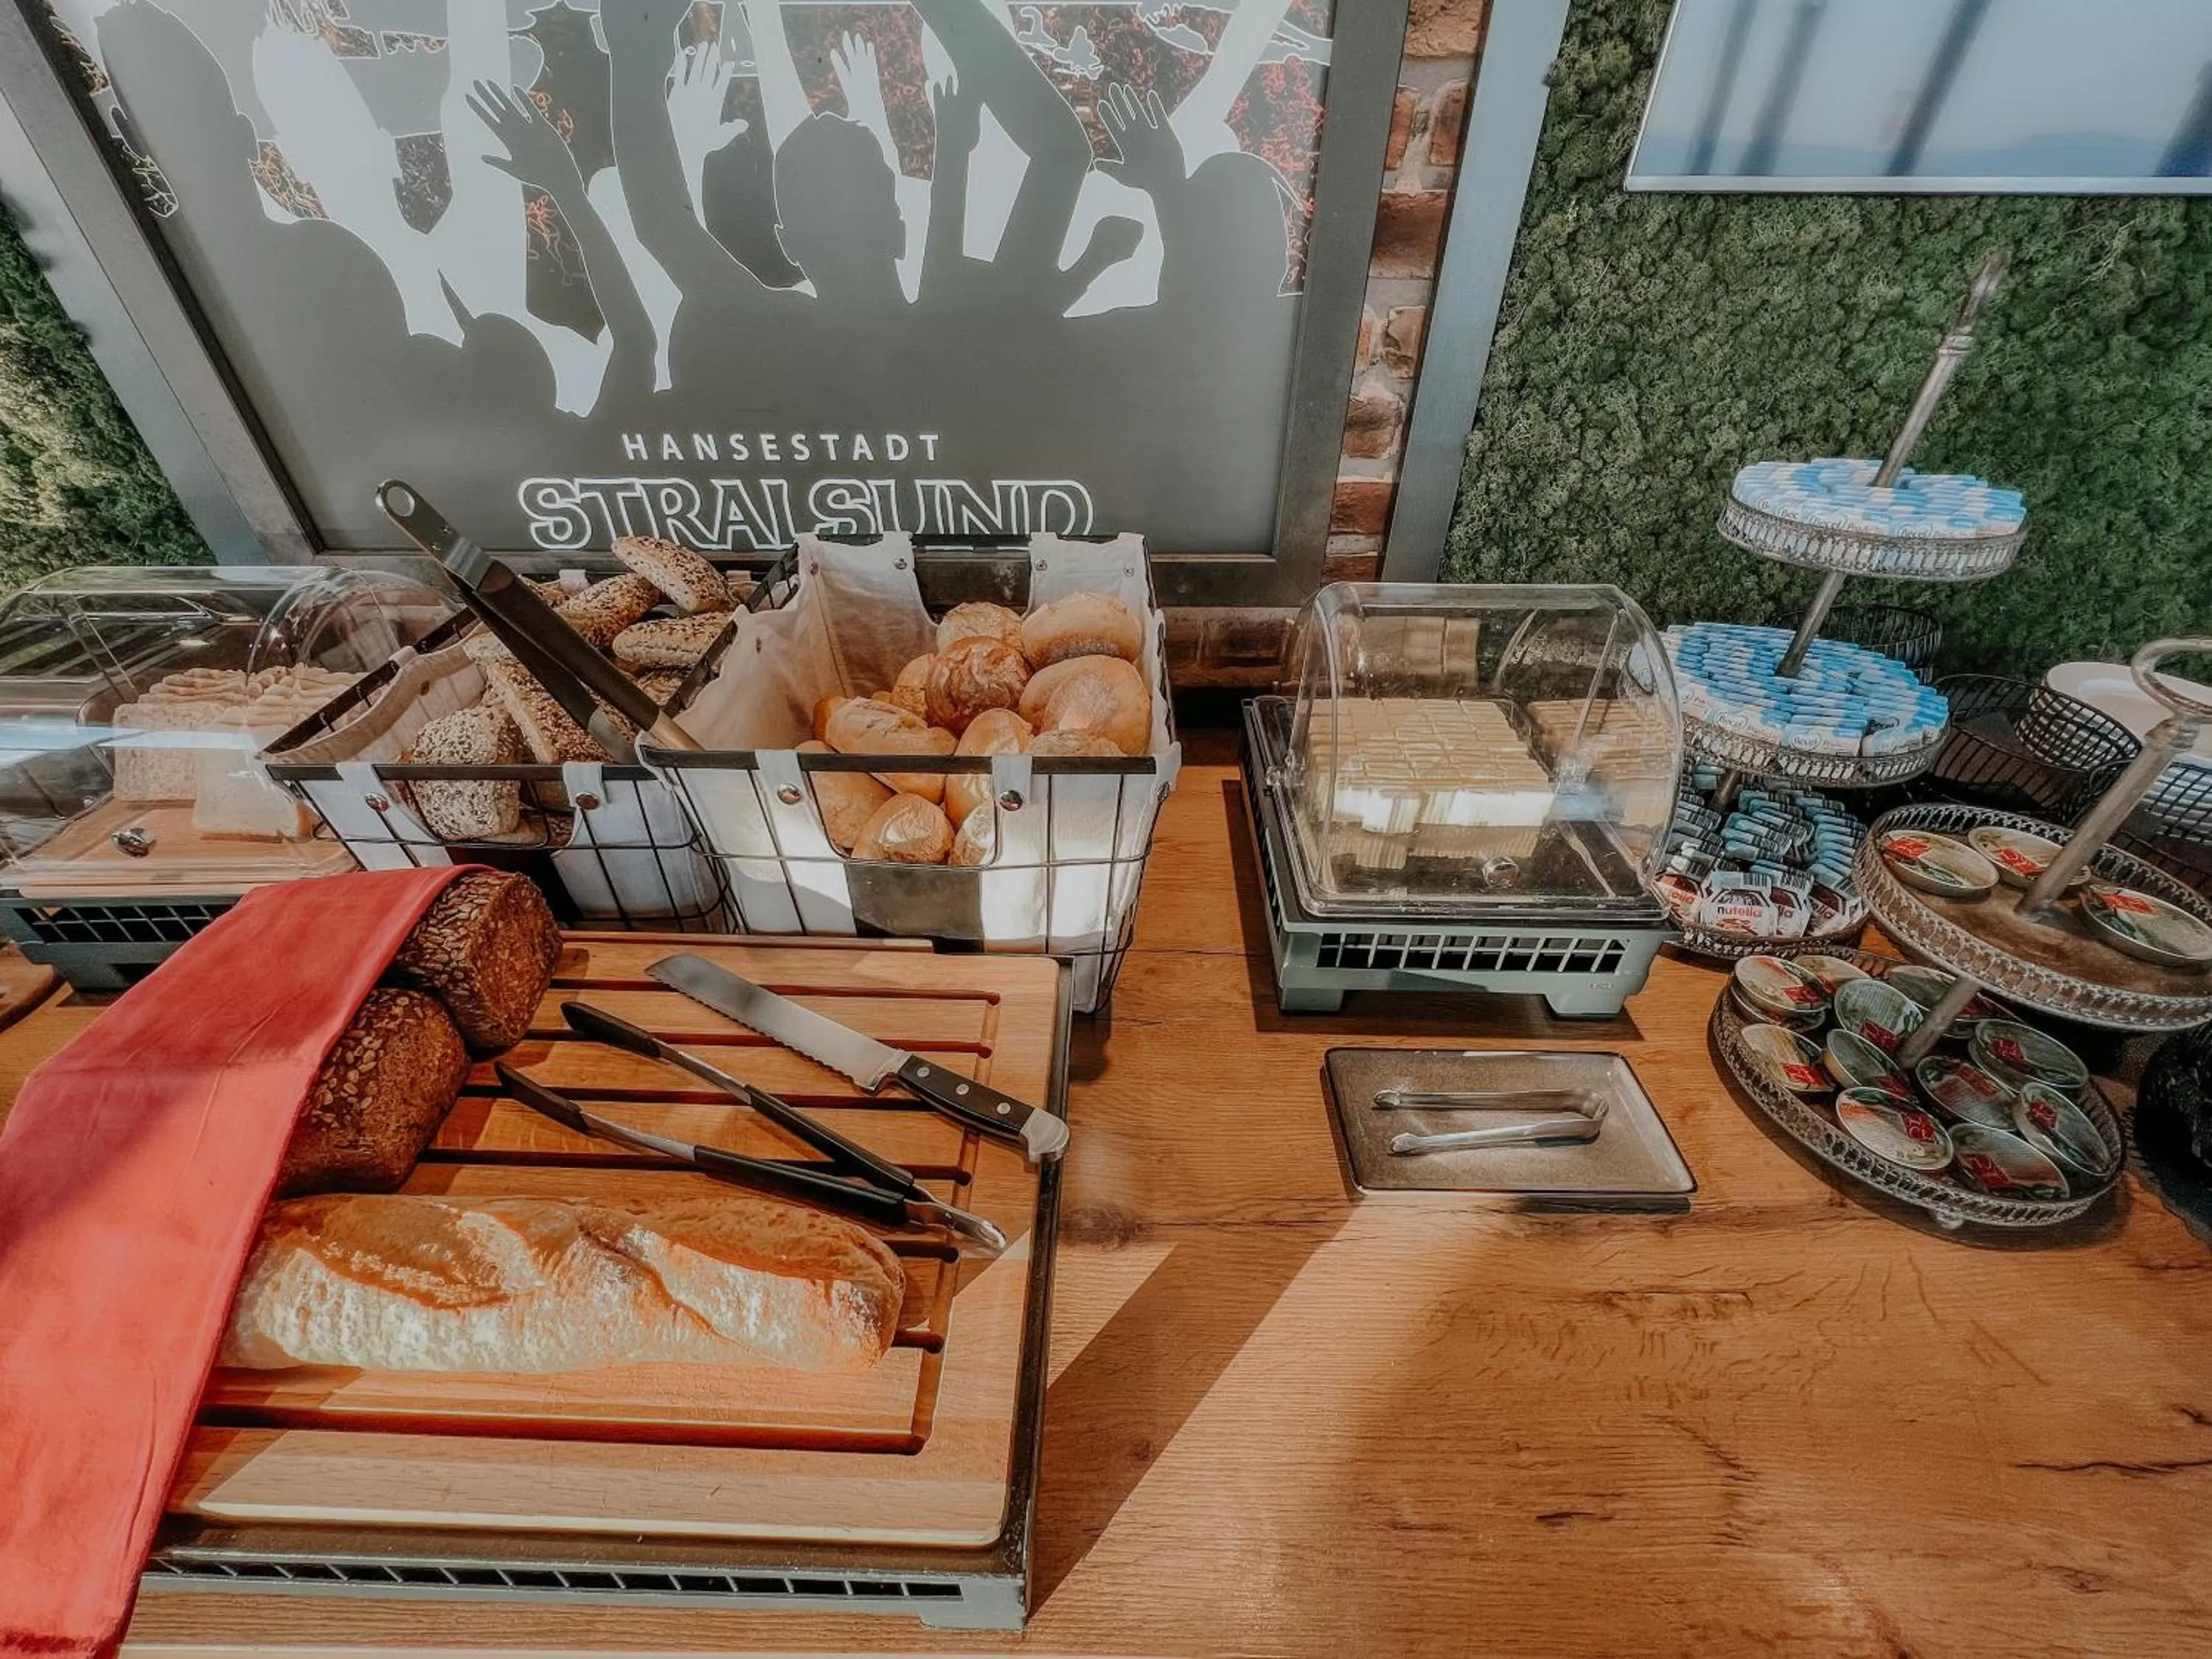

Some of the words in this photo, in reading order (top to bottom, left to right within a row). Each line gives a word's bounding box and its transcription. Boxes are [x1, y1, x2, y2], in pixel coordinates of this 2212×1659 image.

[622, 434, 940, 461] HANSESTADT
[518, 476, 1094, 549] STRALSUND
[1717, 905, 1762, 918] nutella
